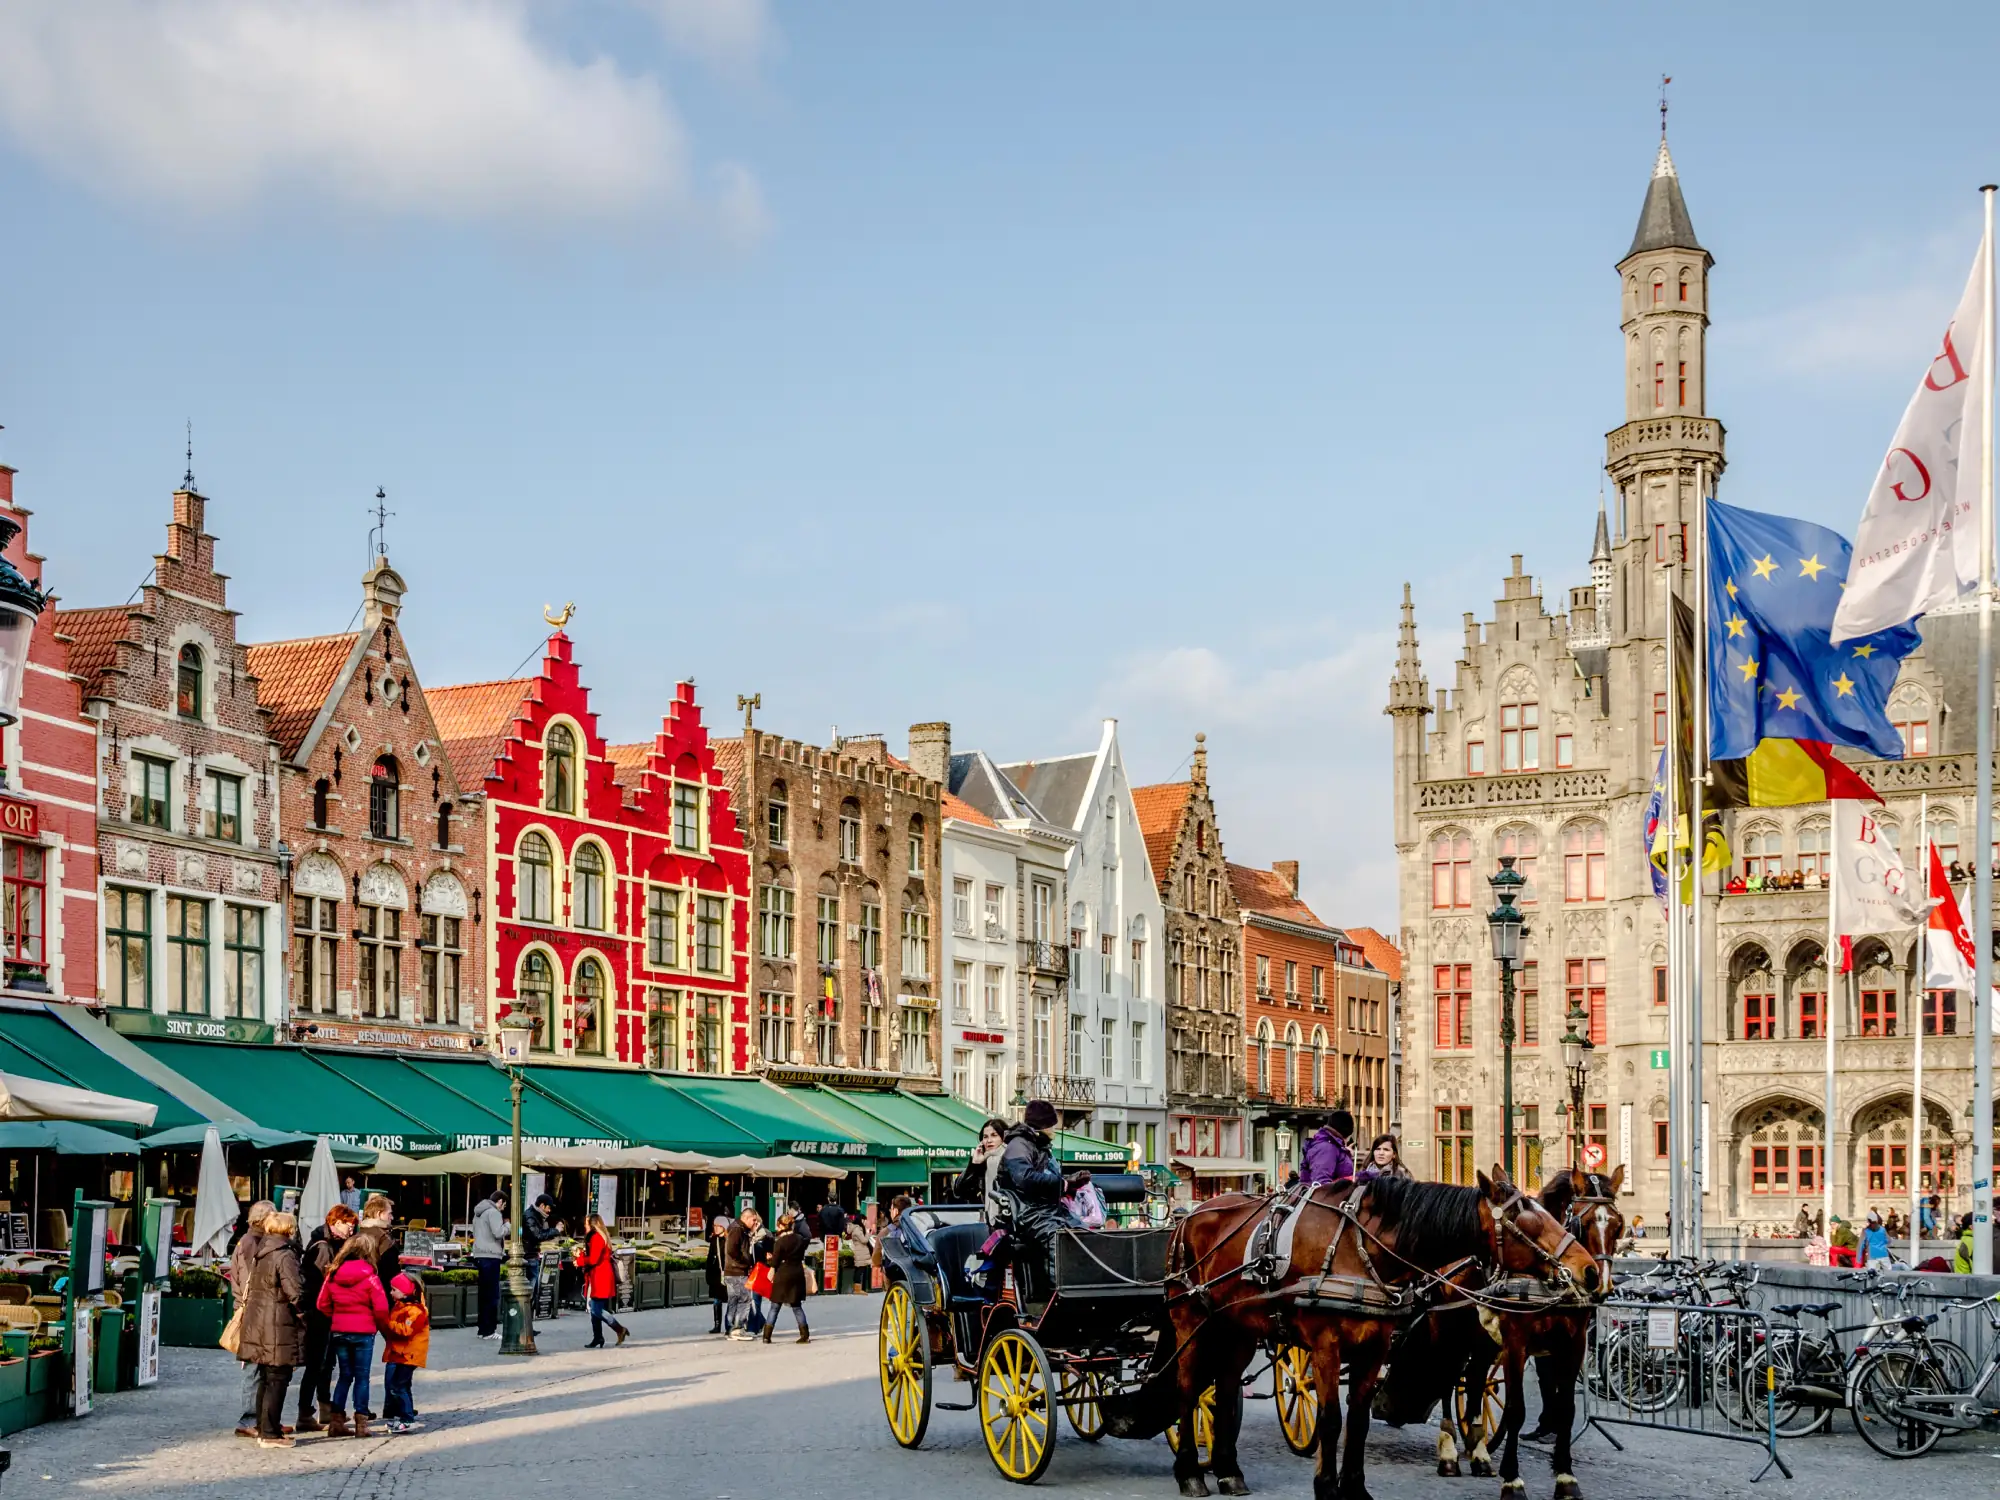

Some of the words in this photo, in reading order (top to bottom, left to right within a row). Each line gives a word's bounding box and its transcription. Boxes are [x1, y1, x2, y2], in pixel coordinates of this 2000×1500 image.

[371, 764, 388, 779] OTEL
[0, 802, 33, 832] OR
[166, 1020, 192, 1035] SINT
[195, 1022, 226, 1037] JORIS
[358, 1031, 413, 1045] RESTAURANT
[768, 1070, 824, 1081] RESTAURANT
[410, 1141, 442, 1151] Brasserie
[456, 1134, 492, 1149] HOTEL
[498, 1136, 570, 1149] RETAURANT
[791, 1141, 817, 1153] CAFE
[820, 1142, 839, 1154] DES
[841, 1143, 868, 1156] ARTS
[897, 1147, 924, 1157] Brasserie
[1074, 1151, 1102, 1161] Friterie
[1104, 1151, 1124, 1161] 1900
